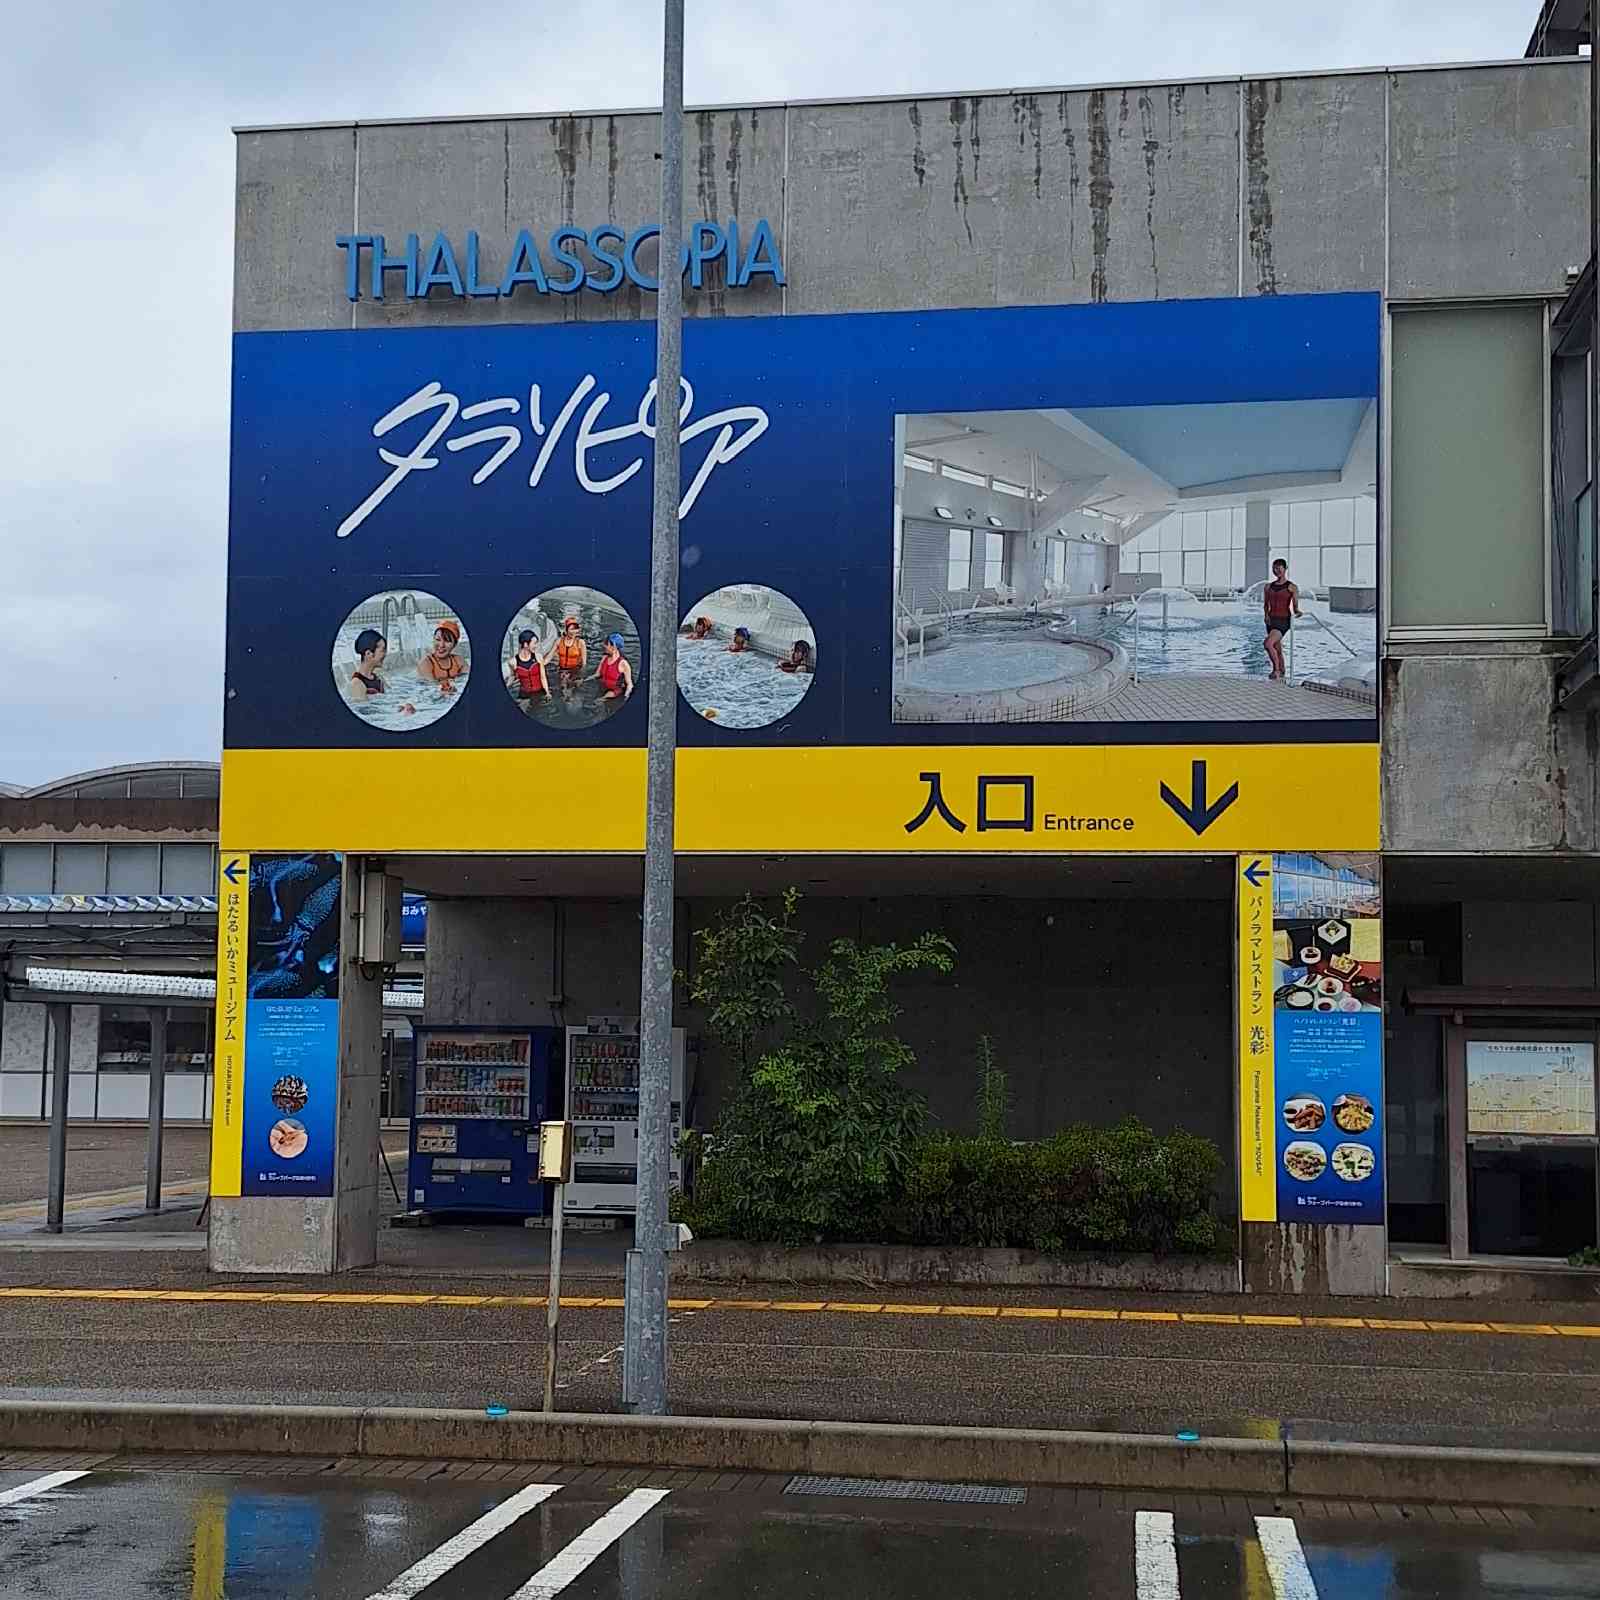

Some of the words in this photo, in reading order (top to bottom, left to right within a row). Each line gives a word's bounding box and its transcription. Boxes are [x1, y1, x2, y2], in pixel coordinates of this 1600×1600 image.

[336, 217, 788, 302] THALASSOPIA
[904, 771, 1035, 834] 入口
[1044, 814, 1135, 832] Entrance
[223, 893, 241, 1042] ほたるいかミュージアム
[1248, 895, 1264, 1015] パノラマレストラン
[1249, 1024, 1266, 1056] 光彩
